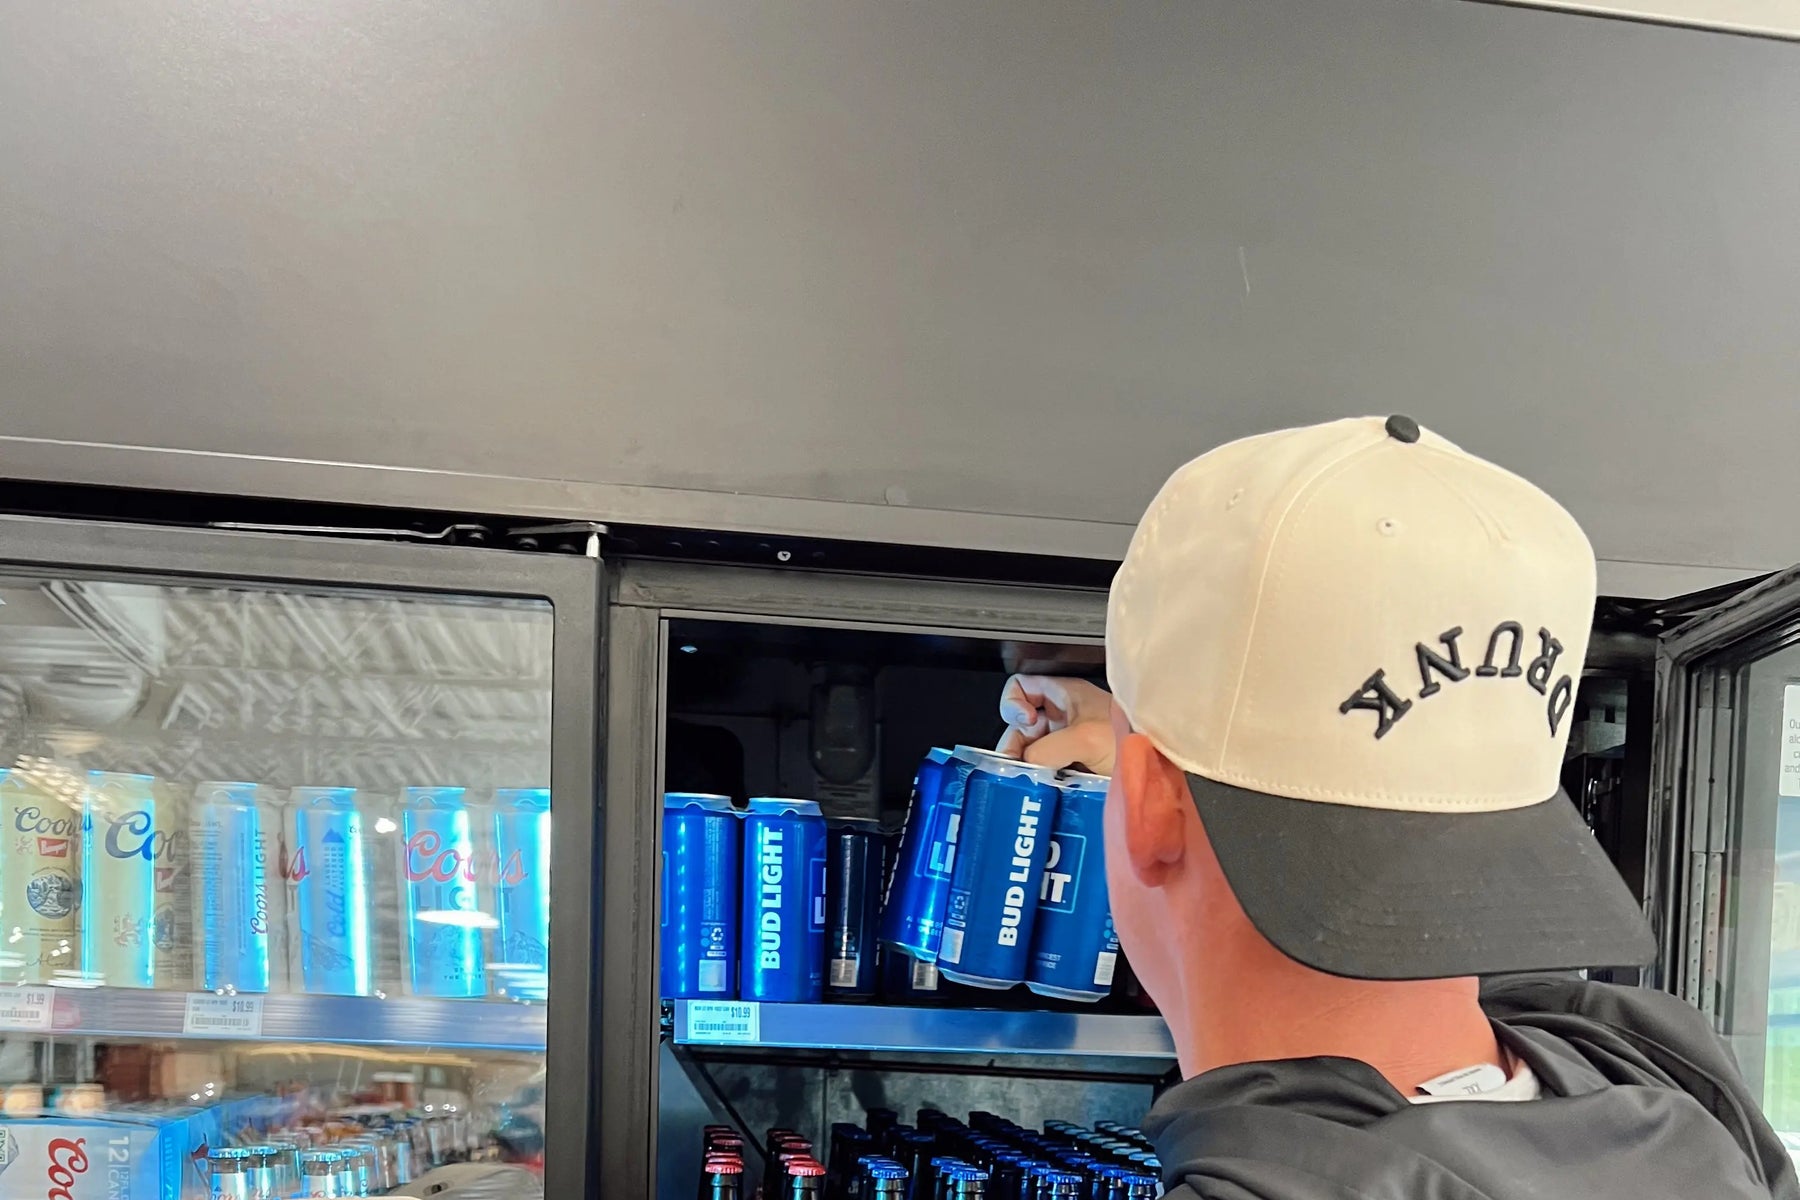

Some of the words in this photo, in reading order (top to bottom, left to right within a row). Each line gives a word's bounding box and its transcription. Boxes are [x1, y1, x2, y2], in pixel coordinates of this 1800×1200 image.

[1339, 620, 1573, 740] DRUNK
[14, 806, 76, 837] Coor
[1008, 796, 1042, 883] LIGHT
[761, 826, 783, 909] LIGHT
[760, 909, 782, 970] BUD
[997, 885, 1026, 947] BUD
[108, 1136, 129, 1162] 12
